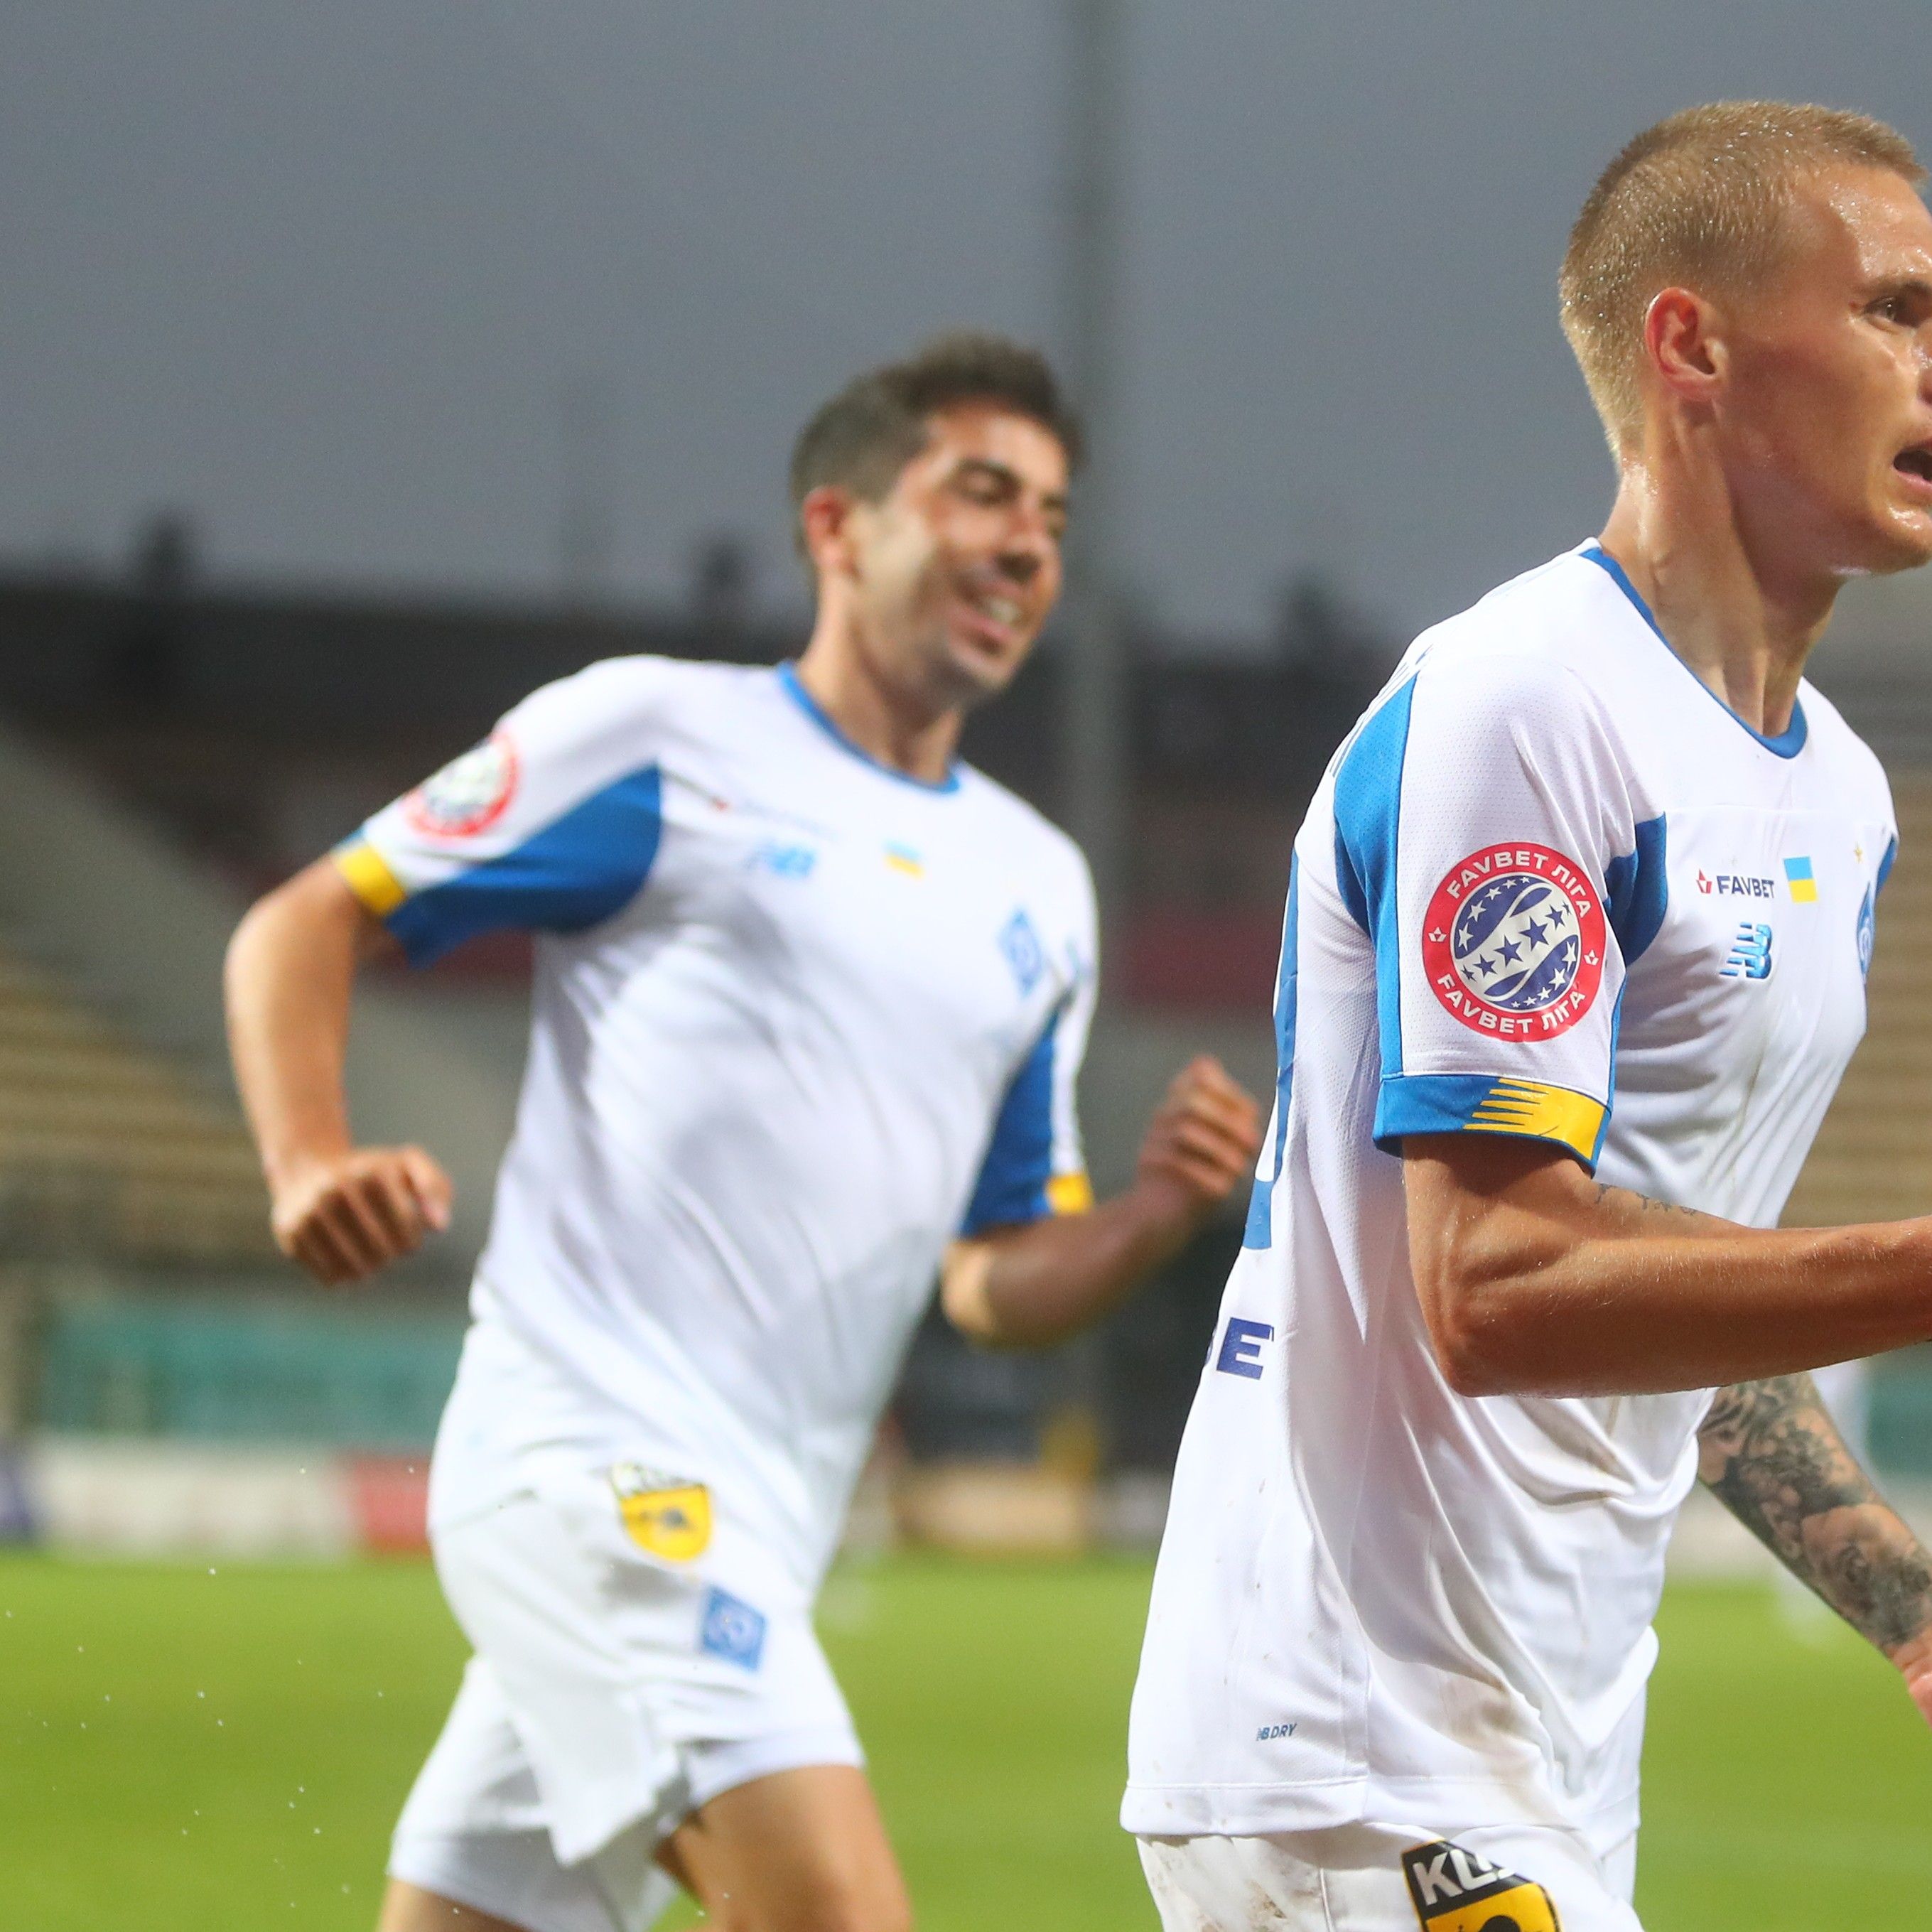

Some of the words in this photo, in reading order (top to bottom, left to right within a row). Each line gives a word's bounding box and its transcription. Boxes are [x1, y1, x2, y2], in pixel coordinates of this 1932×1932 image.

[1446, 851, 1549, 899] FAVBET
[1716, 875, 1775, 899] FAVBET
[1437, 973, 1533, 1034] FAVBET
[1207, 1317, 1274, 1380] E
[1413, 1849, 1515, 1906] KL
